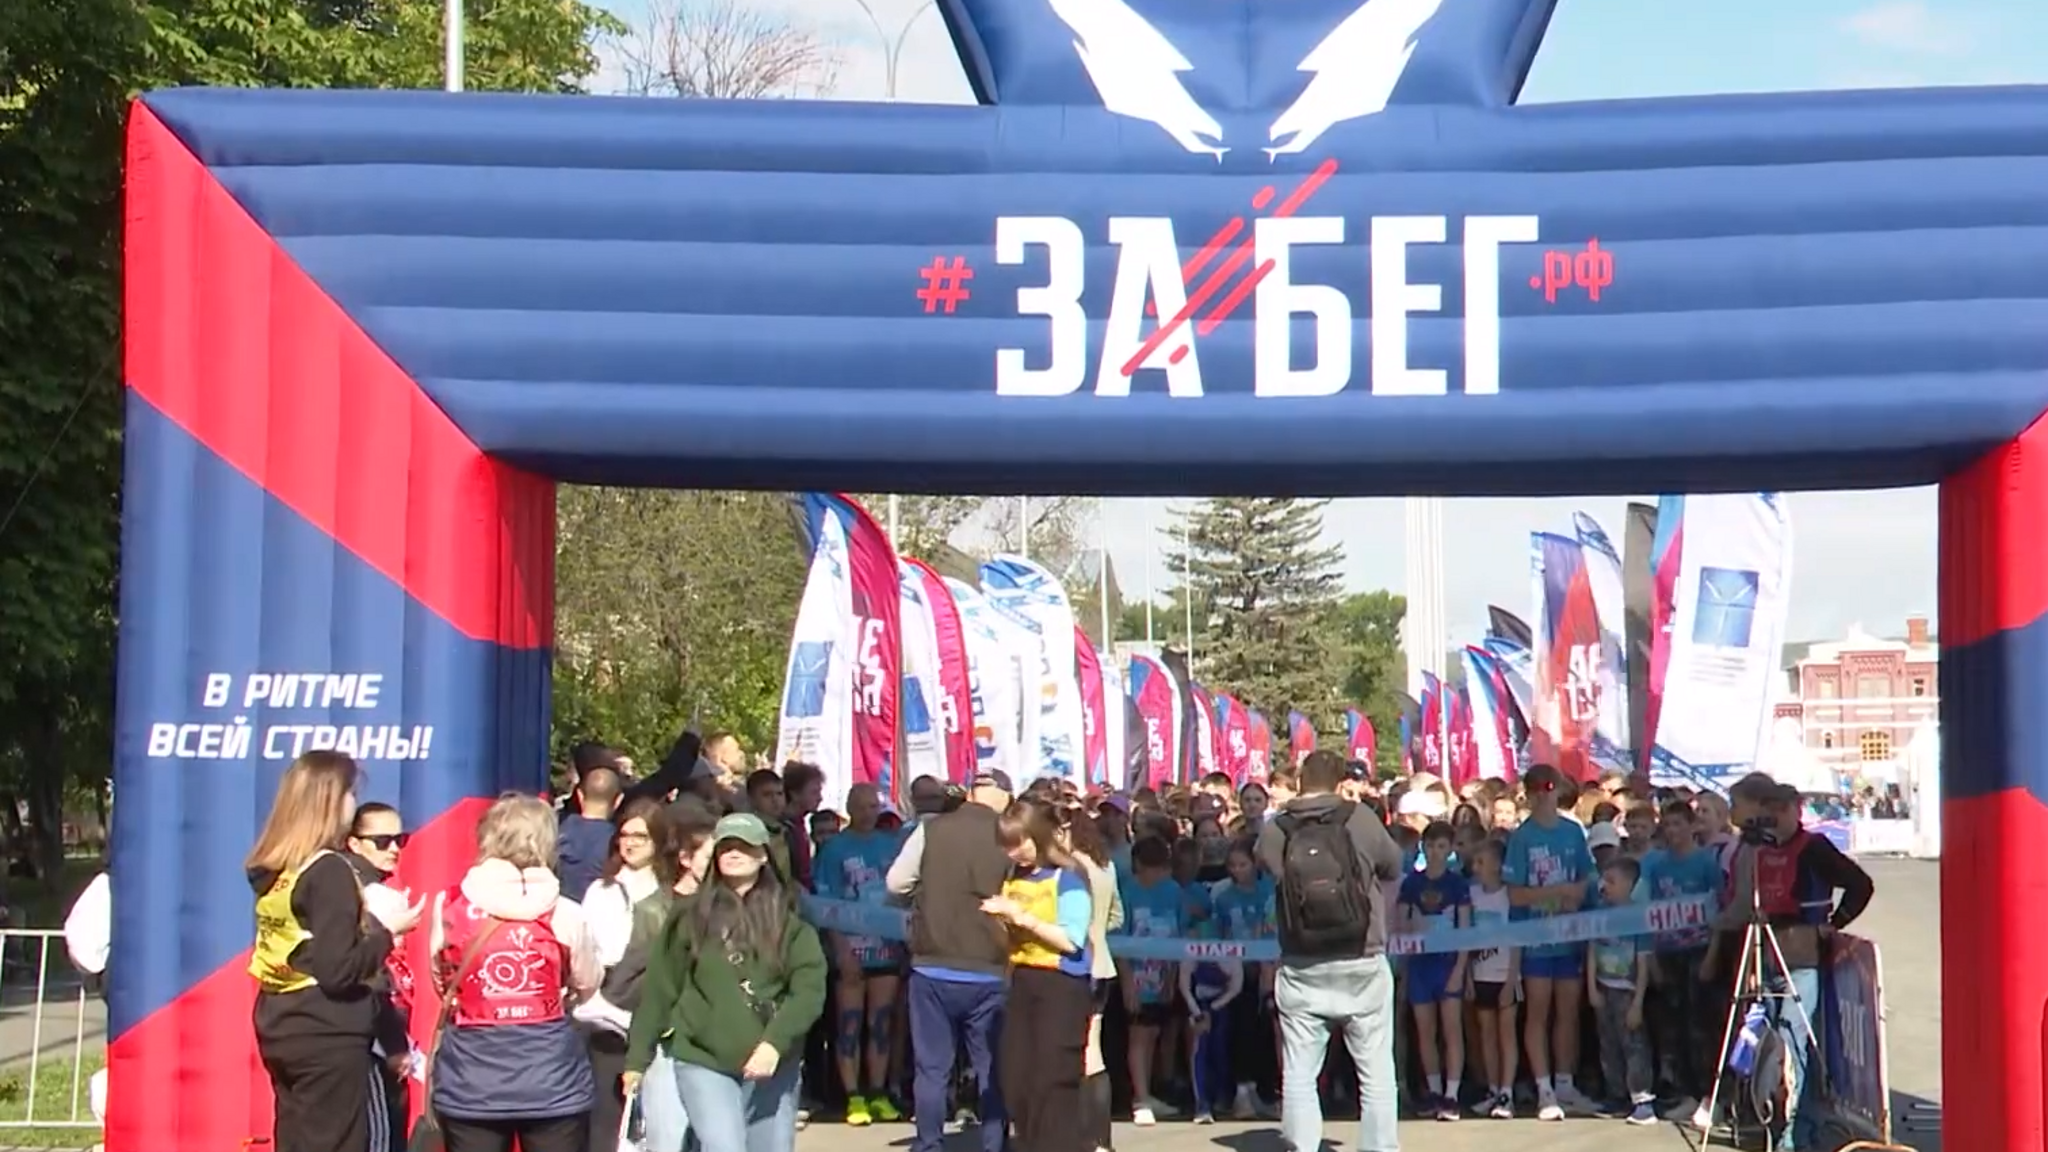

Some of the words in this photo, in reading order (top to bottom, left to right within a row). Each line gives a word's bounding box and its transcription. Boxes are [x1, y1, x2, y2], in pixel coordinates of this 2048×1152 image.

[203, 672, 231, 708] В
[244, 672, 383, 709] РИТМЕ
[148, 716, 252, 758] ВСЕЙ
[263, 725, 434, 760] СТРАНЫ!
[1644, 899, 1706, 932] СТАРТ
[1184, 942, 1246, 958] СТАРТ
